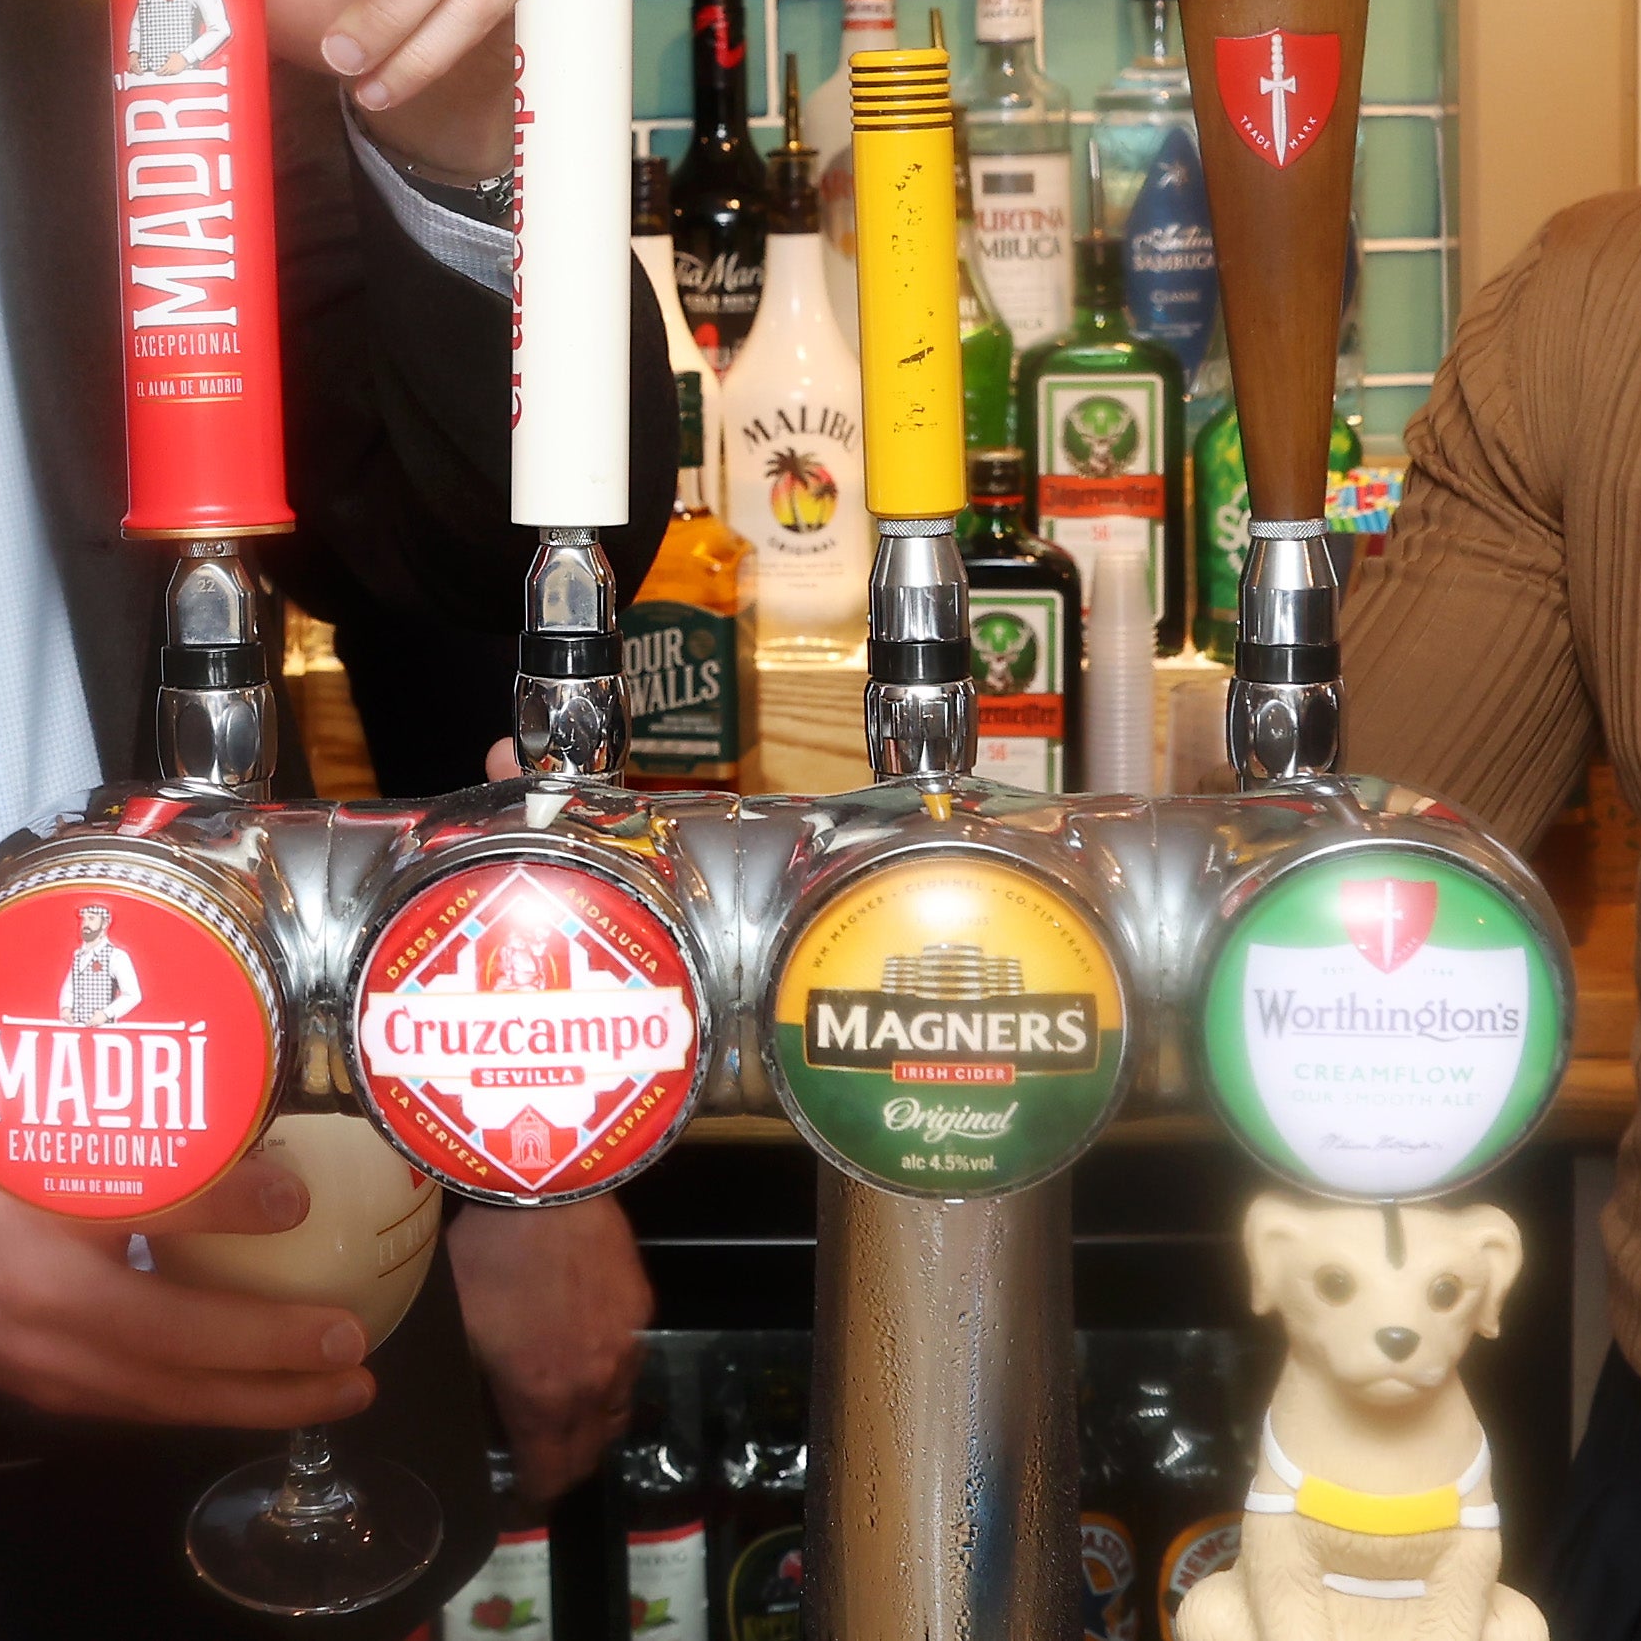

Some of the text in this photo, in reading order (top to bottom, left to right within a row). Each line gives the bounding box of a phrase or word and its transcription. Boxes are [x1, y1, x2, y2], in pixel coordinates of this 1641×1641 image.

[1239, 115, 1271, 150] TRADE
[1288, 116, 1318, 150] MARK
[134, 332, 241, 357] EXCEPCIONAL
[137, 378, 243, 397] EL ALMA DE MADRID
[743, 405, 858, 454] MALIBU
[623, 626, 685, 677] OUR
[386, 887, 479, 979] DESDE 1904
[563, 887, 660, 974] ANDALUCÍA
[812, 945, 830, 970] WM
[831, 895, 886, 942] MAGNER
[383, 1005, 670, 1060] Cruzcampo
[816, 1003, 1088, 1054] MAGNERS
[1254, 988, 1519, 1042] Worthington's
[480, 1068, 575, 1086] SEVILLA
[902, 1066, 1007, 1082] IRISH CIDER
[1294, 1062, 1475, 1085] CREAMFLOW
[389, 1086, 490, 1177] LA CERVEZA
[580, 1085, 667, 1171] DE ESPAÑA
[882, 1096, 1019, 1143] Original
[8, 1130, 179, 1168] EXCEPCIONAL
[902, 1155, 927, 1170] alc
[44, 1177, 144, 1195] EL ALMA DE MADRID
